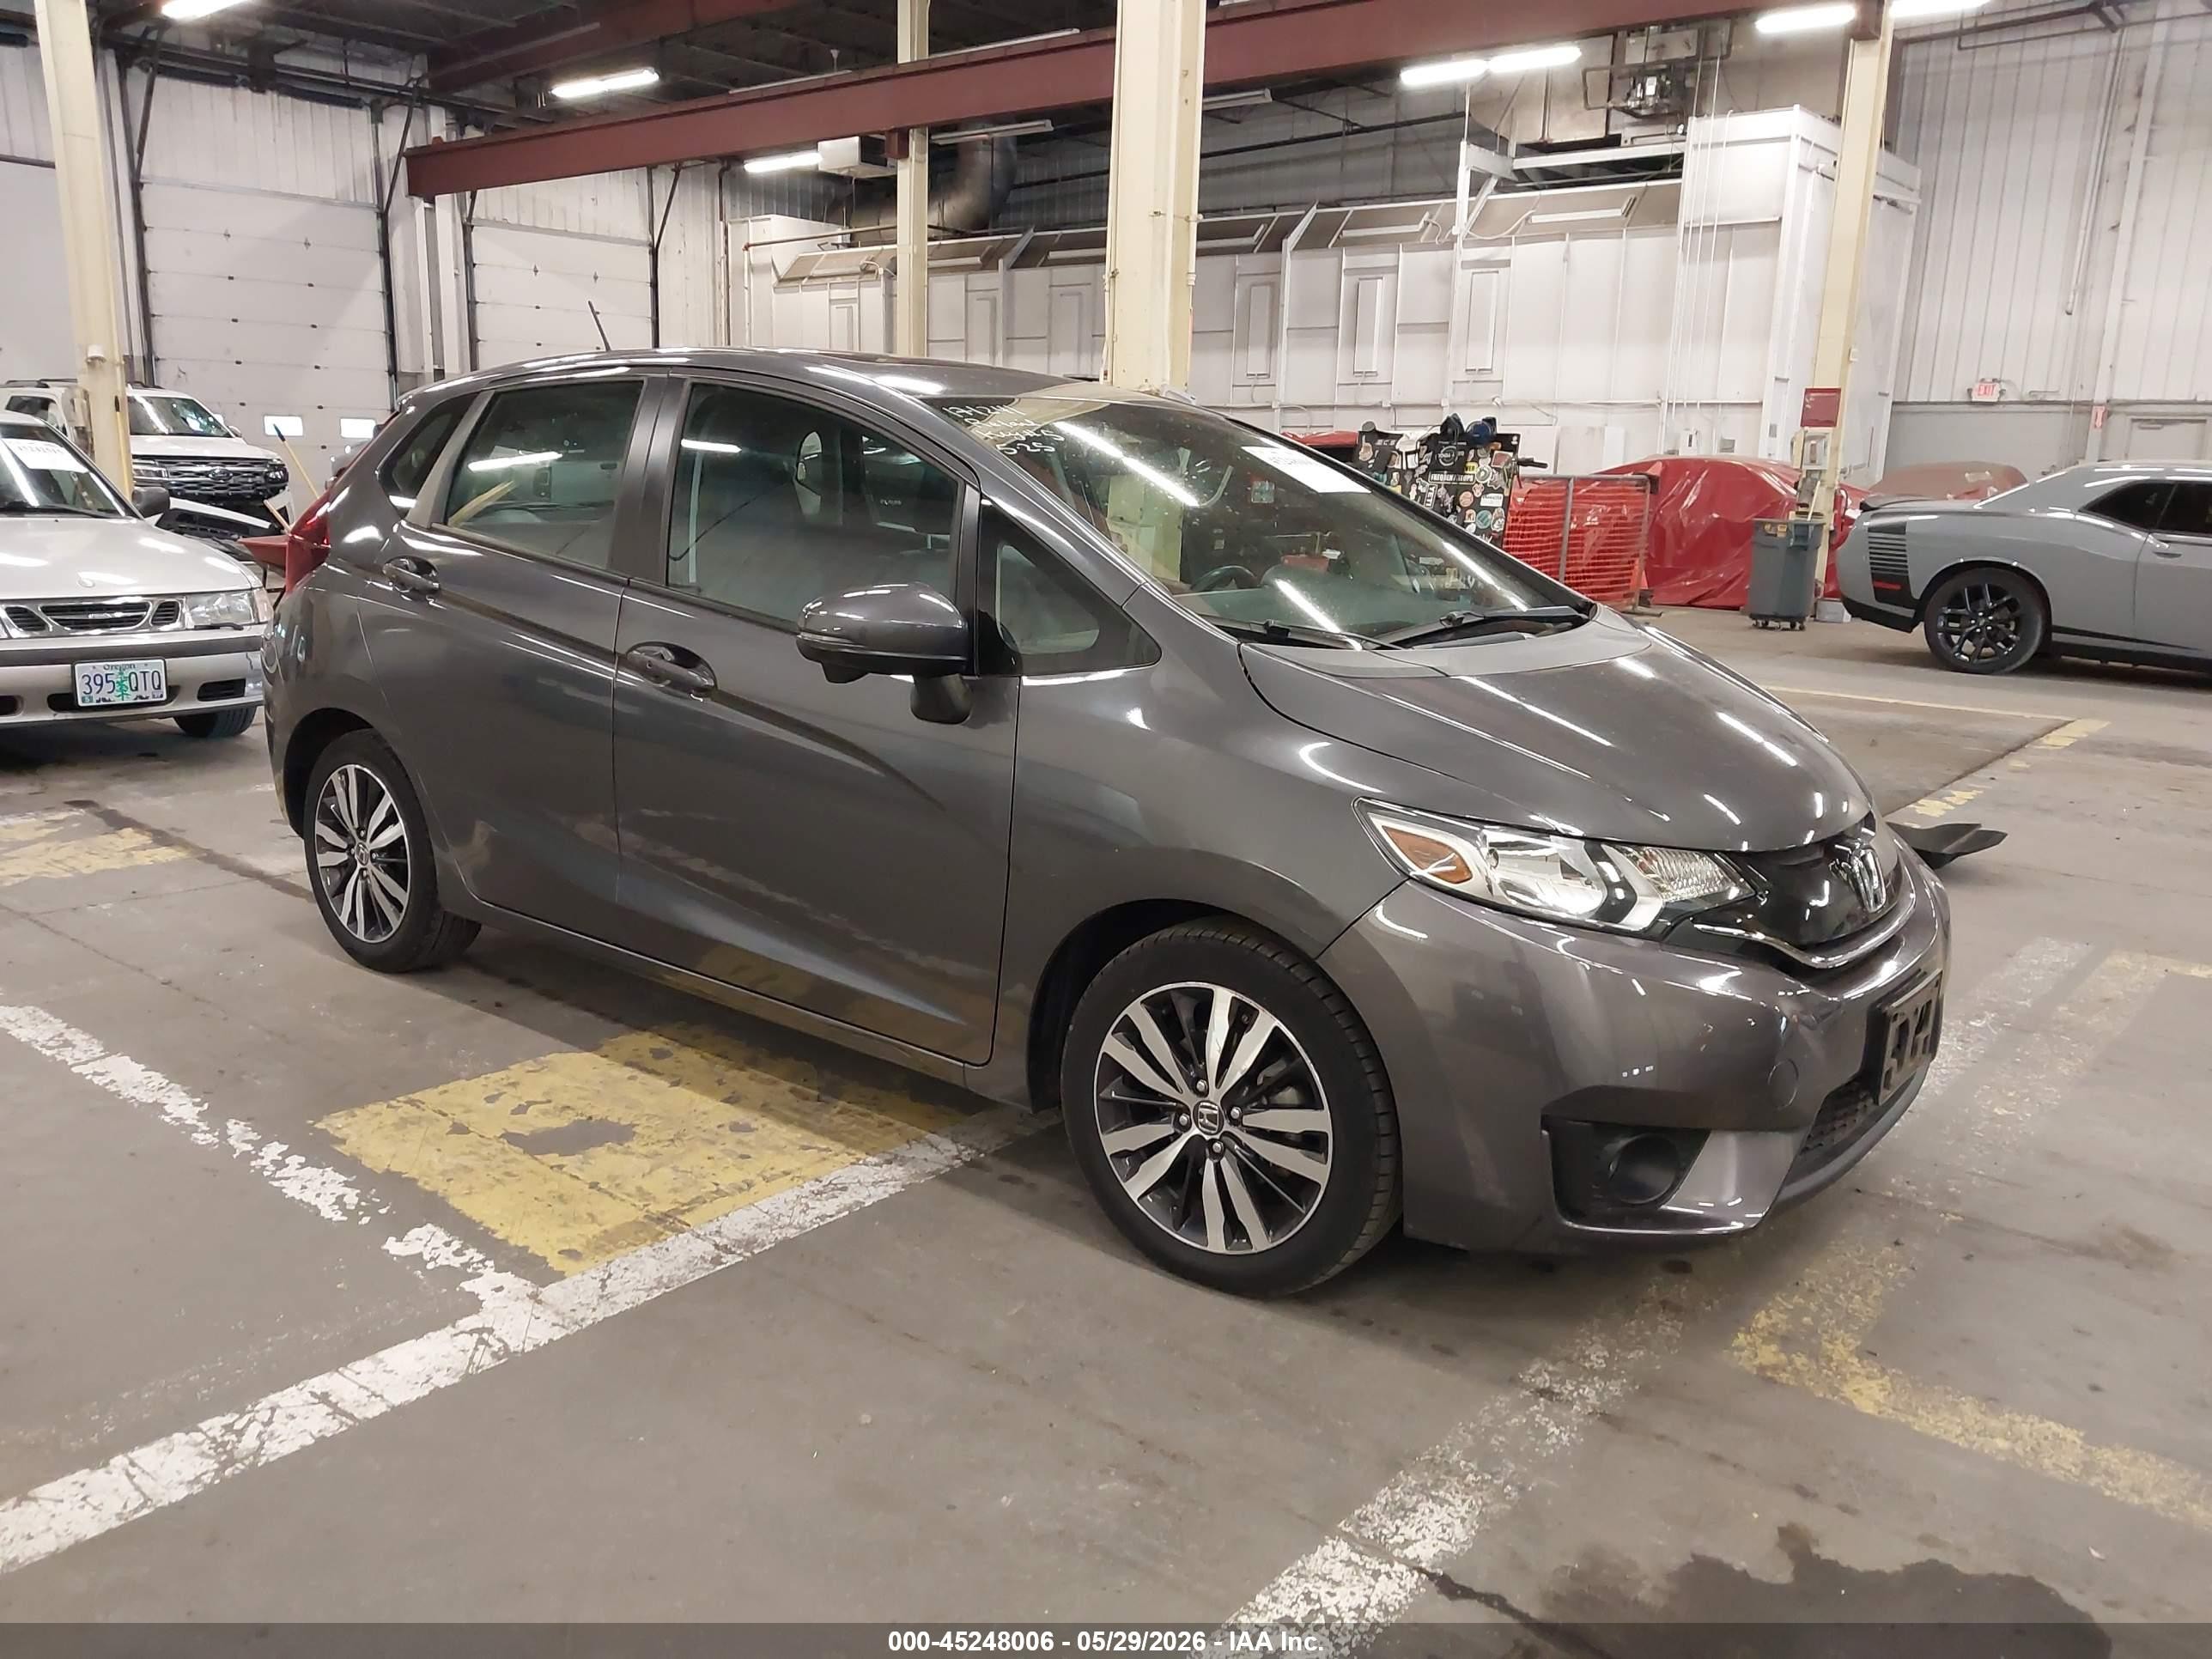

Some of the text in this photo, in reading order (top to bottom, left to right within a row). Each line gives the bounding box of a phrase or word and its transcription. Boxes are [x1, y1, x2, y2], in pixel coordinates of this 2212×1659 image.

[1978, 384, 1997, 396] EXIT
[1425, 486, 1436, 507] YETI
[82, 672, 116, 695] 395
